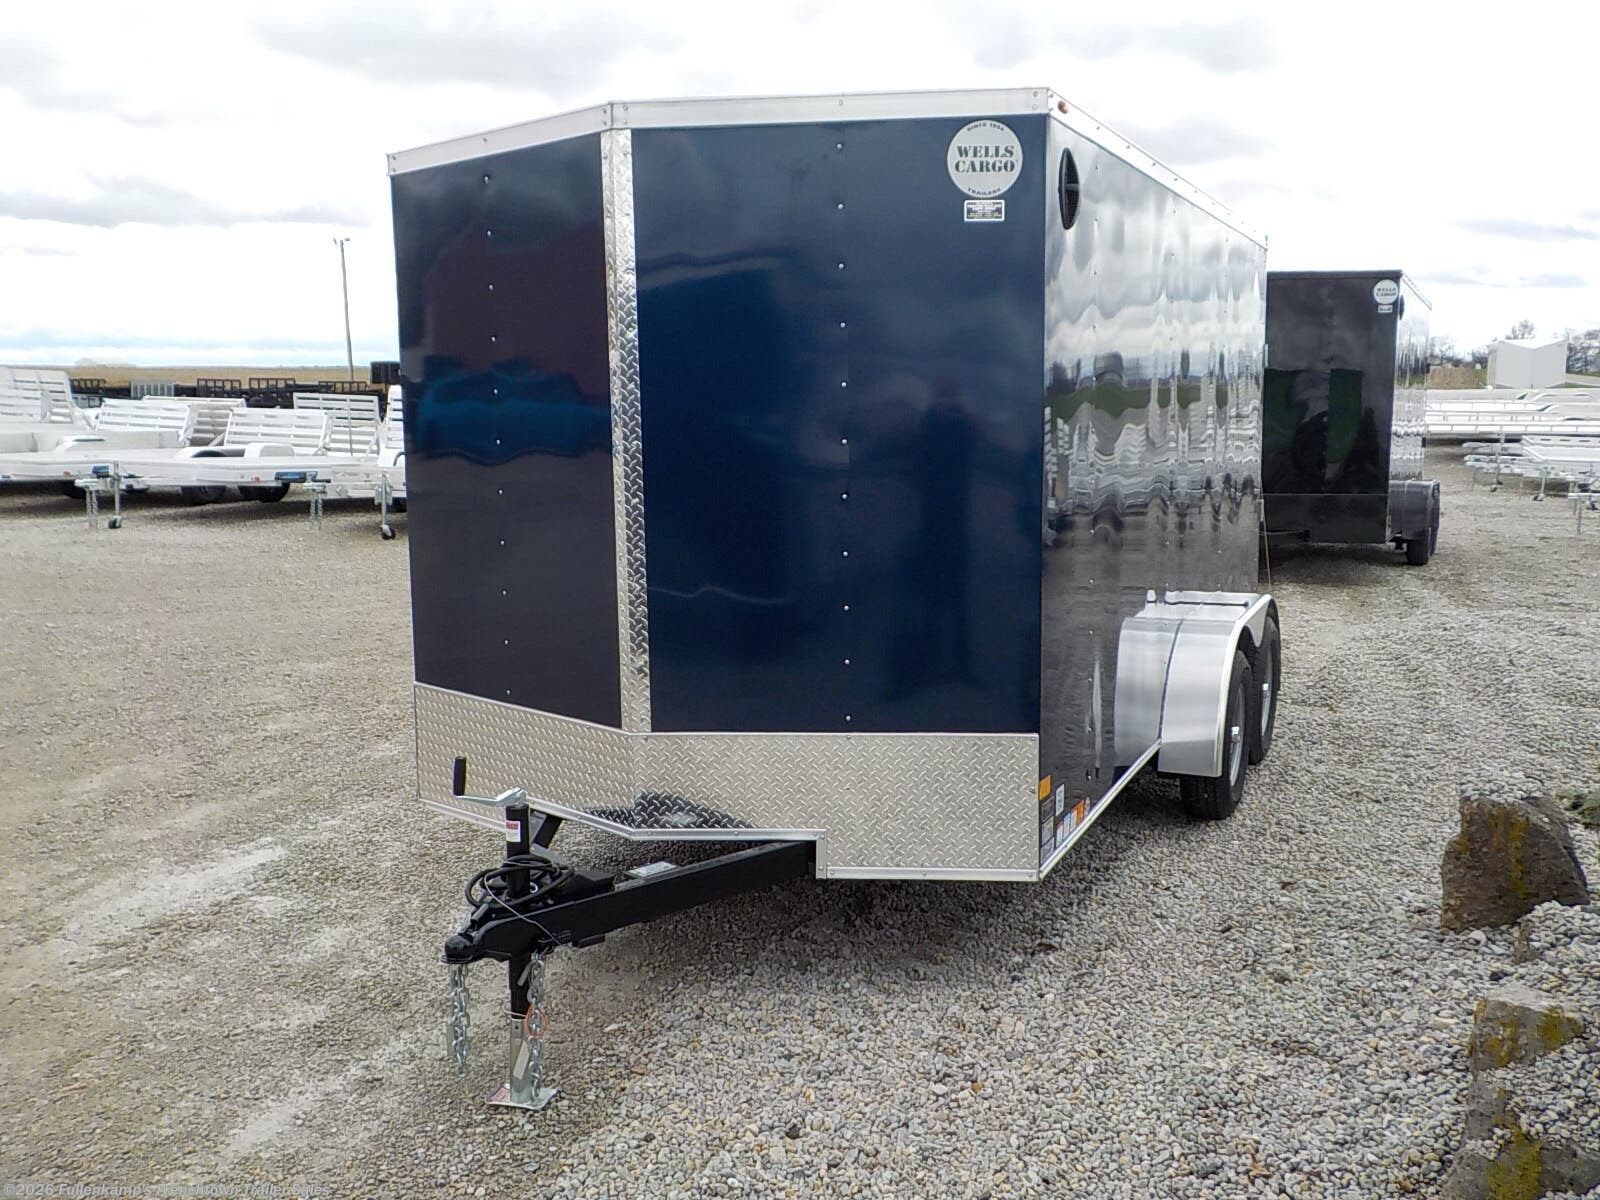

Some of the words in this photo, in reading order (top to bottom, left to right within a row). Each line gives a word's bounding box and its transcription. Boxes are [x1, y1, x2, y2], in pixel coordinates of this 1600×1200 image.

[966, 122, 987, 132] SINCE
[956, 145, 1015, 158] WELLS
[954, 160, 1016, 173] CARGO
[967, 187, 1001, 196] TRAILERS
